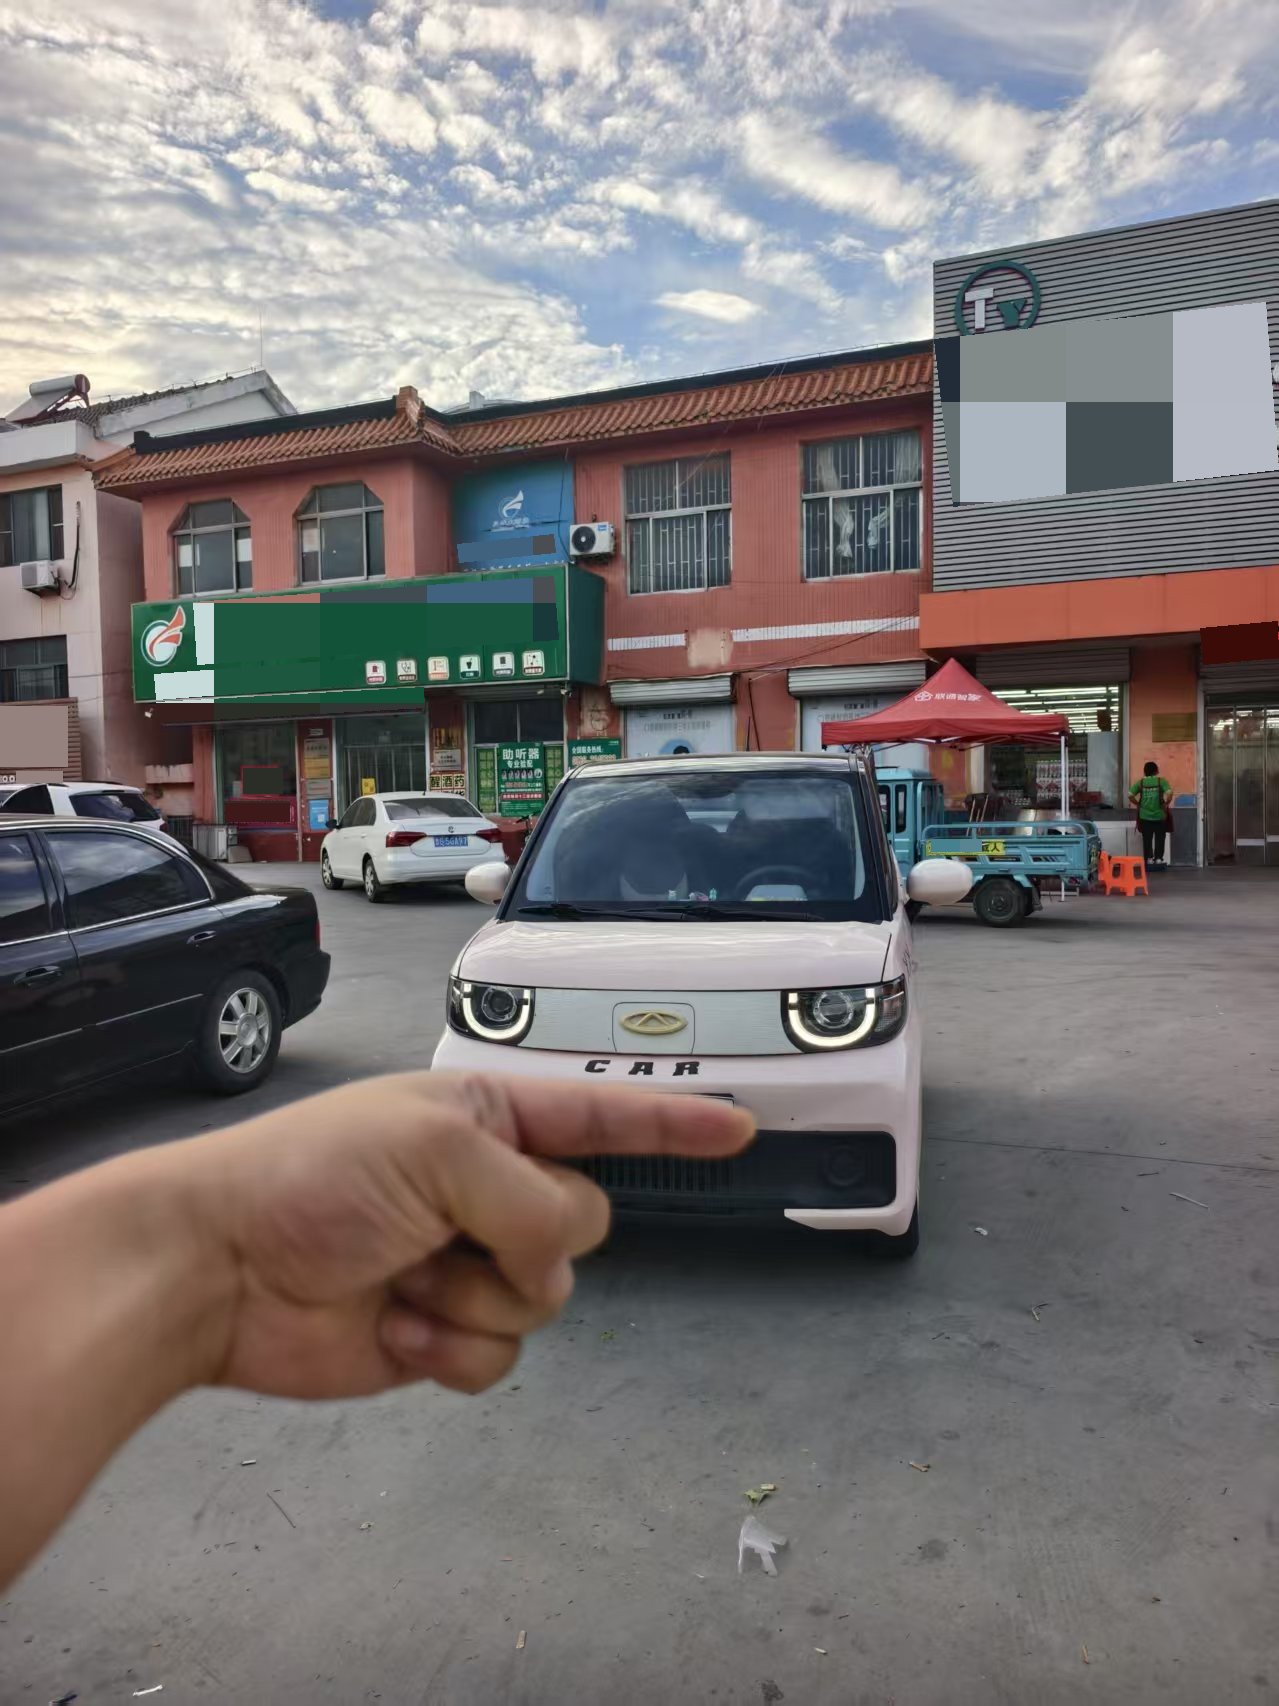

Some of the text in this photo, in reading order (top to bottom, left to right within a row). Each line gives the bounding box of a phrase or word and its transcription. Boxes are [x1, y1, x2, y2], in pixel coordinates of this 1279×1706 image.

[502, 748, 540, 760] 助听器
[430, 775, 465, 788] 醒酒药
[584, 1059, 700, 1077] CAR
